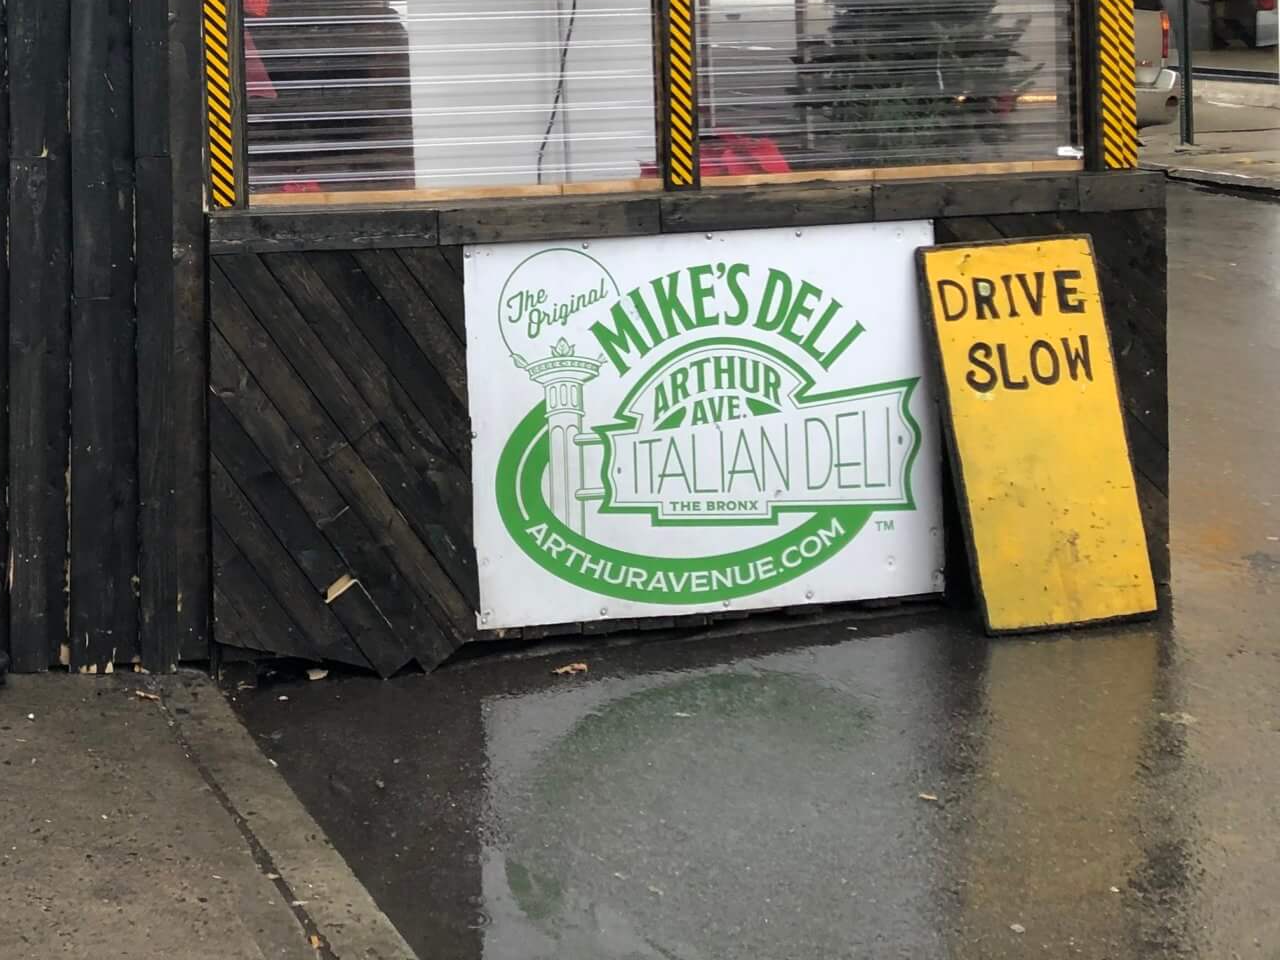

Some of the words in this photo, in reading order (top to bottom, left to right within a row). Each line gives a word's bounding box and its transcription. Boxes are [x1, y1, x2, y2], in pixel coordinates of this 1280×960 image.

[506, 288, 548, 324] The
[527, 278, 608, 339] Original
[588, 262, 750, 378] MIKE'S
[752, 267, 866, 372] DELI
[937, 270, 1086, 321] DRIVE
[652, 355, 782, 424] ARTHUR
[966, 335, 1094, 393] SLOW
[690, 395, 748, 426] AVE.
[632, 423, 790, 495] ITALIAN
[804, 407, 892, 490] DELI
[670, 500, 701, 512] THE
[706, 500, 759, 512] BRONX
[525, 516, 847, 593] ARTHURAVENUE.COM
